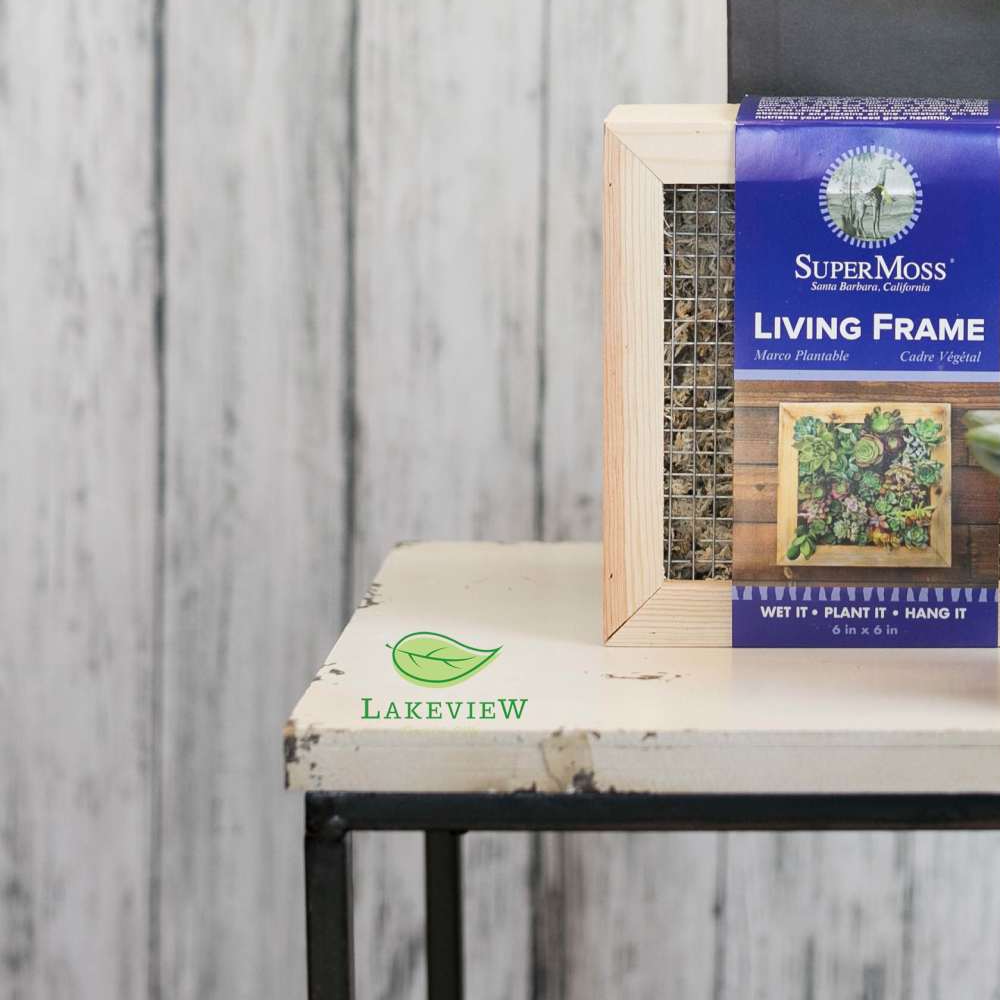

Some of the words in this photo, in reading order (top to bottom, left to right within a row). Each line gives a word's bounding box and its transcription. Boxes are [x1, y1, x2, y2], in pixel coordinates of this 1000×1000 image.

[810, 281, 838, 292] Santa
[839, 281, 881, 293] Barbara,
[883, 281, 931, 293] California
[754, 312, 862, 341] LIVING
[873, 313, 985, 342] FRAME
[754, 350, 792, 362] Marco
[795, 350, 850, 362] Plantable
[900, 351, 935, 363] Cadre
[939, 351, 982, 365] Végétal
[760, 606, 792, 619] WET
[796, 606, 808, 619] IT
[824, 606, 871, 619] PLANT
[874, 607, 887, 619] IT
[905, 607, 951, 620] HANG
[955, 607, 967, 620] IT
[832, 625, 841, 636] 6
[845, 624, 857, 636] in
[861, 627, 870, 636] x
[874, 625, 883, 636] 6
[886, 624, 899, 636] in
